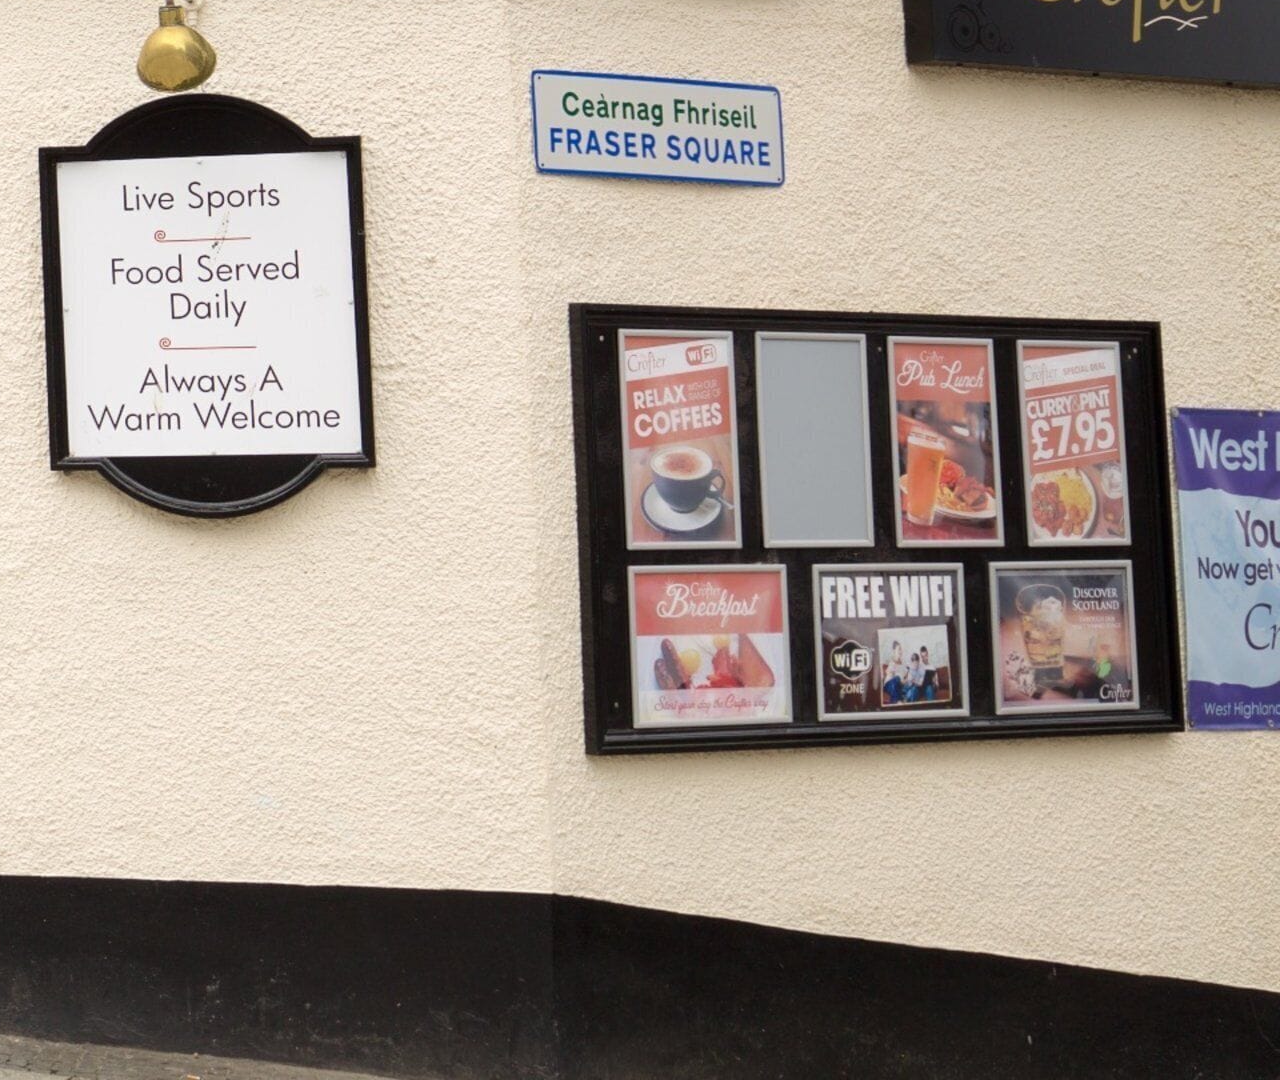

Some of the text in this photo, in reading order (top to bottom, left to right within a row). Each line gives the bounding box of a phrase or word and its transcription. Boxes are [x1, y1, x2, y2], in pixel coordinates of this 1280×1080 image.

[672, 98, 757, 129] Fhriseil
[549, 127, 771, 167] FRASER SQUARE
[122, 181, 281, 217] Live Sports
[111, 249, 300, 285] Food Served
[170, 288, 247, 327] Daily
[139, 364, 284, 401] Always A
[897, 360, 985, 394] Pub Lunch
[633, 384, 687, 410] RELAX
[1027, 395, 1072, 420] CURRY
[1080, 389, 1110, 410] PINT
[87, 399, 341, 431] Warm Welcome
[634, 402, 723, 437] COFFEES
[1031, 409, 1115, 461] £7.95
[1189, 428, 1268, 471] West
[1198, 557, 1240, 580] Now
[1244, 558, 1273, 586] get
[656, 584, 760, 628] Breakfast
[822, 575, 953, 618] FREE WIFI
[840, 683, 865, 694] ZONE
[1204, 701, 1232, 717] West
